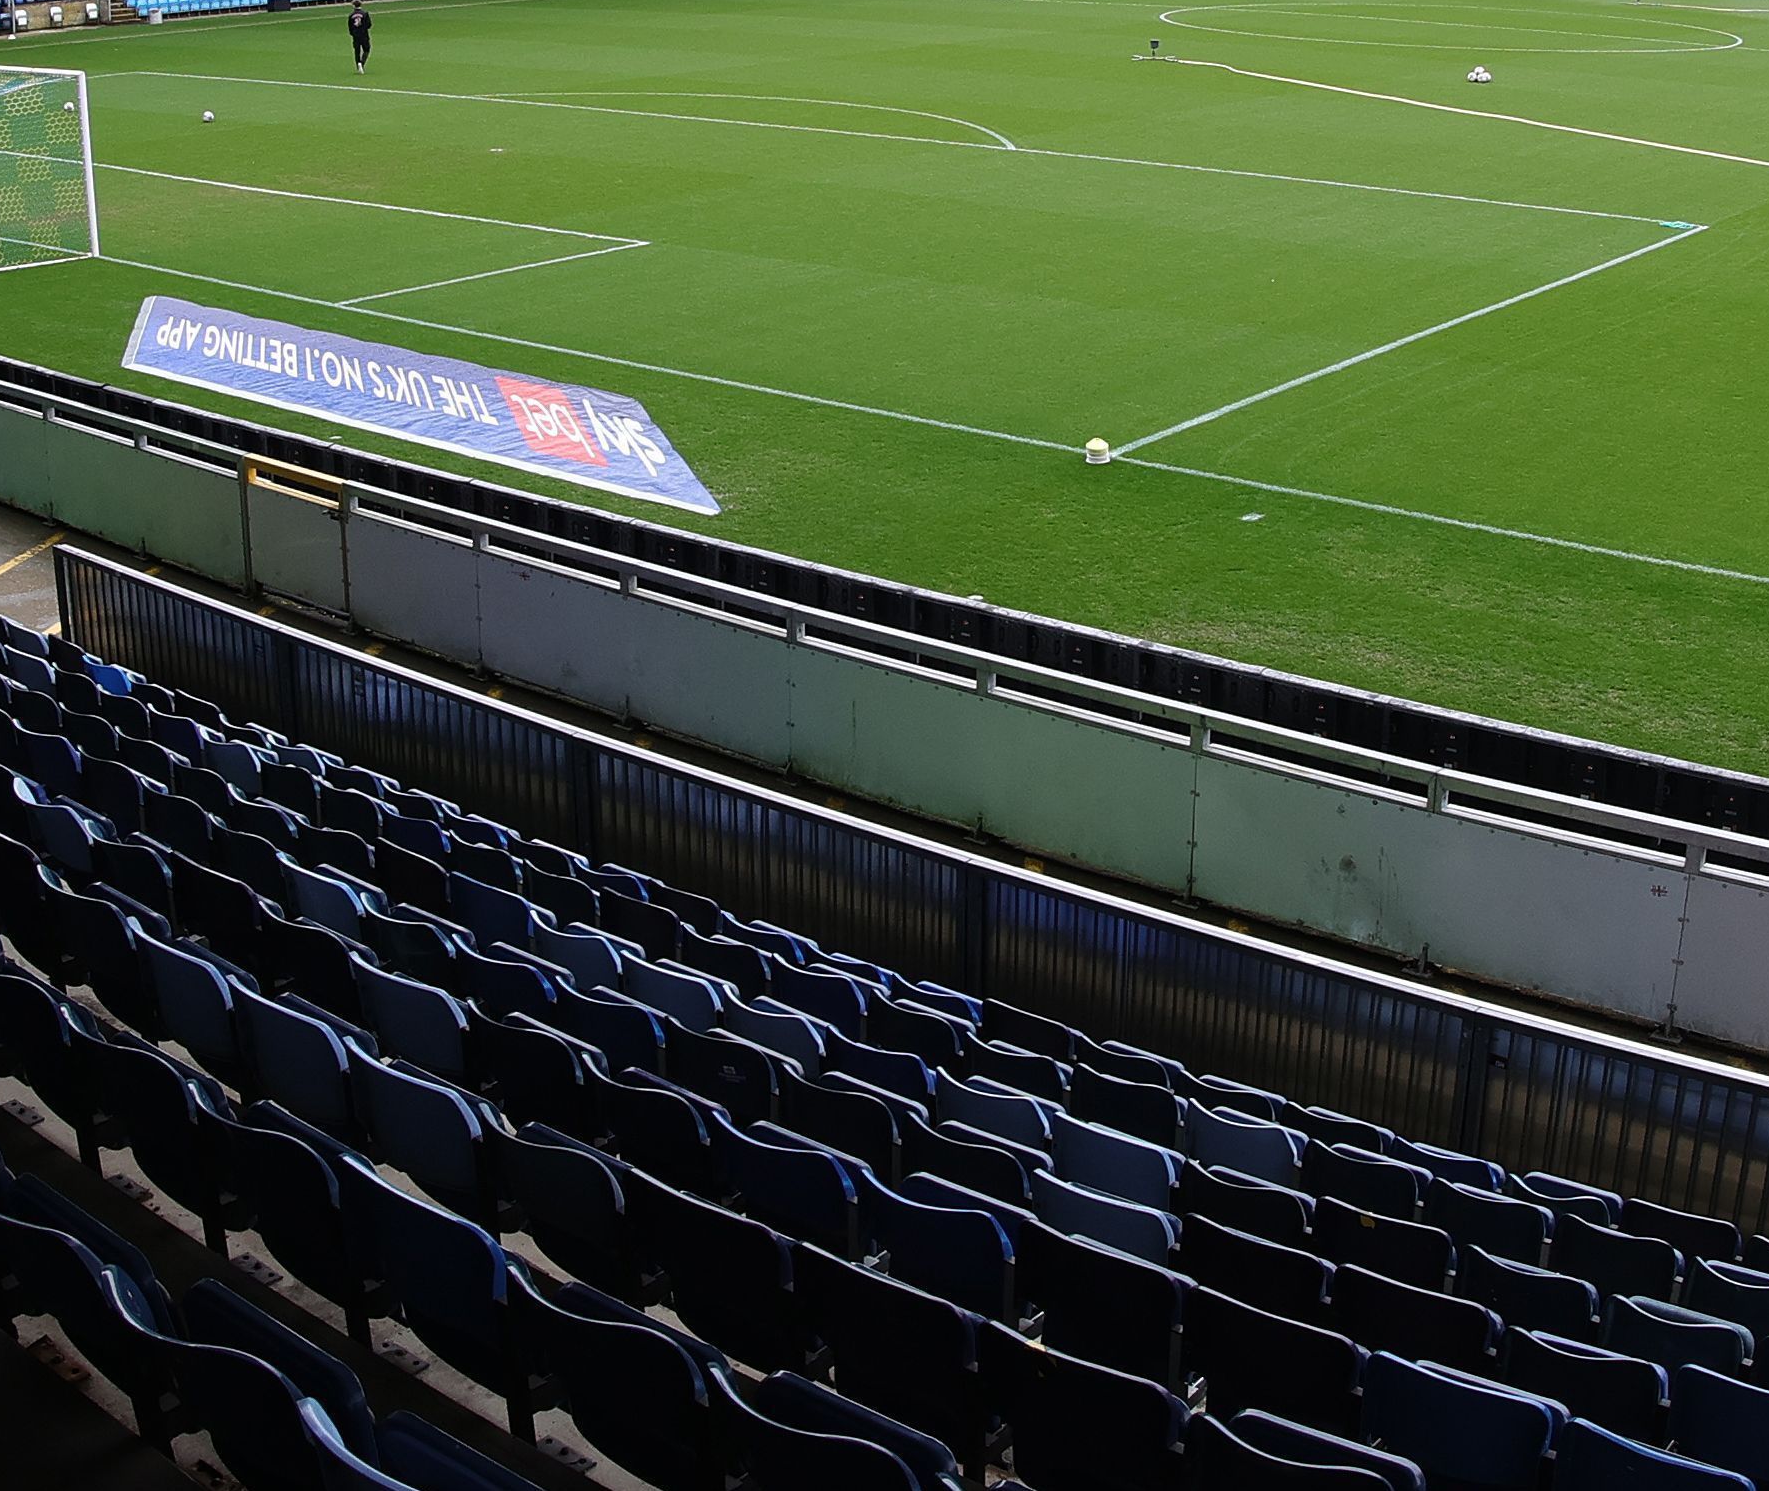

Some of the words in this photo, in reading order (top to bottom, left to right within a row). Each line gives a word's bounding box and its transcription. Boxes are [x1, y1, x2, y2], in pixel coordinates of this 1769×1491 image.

[156, 316, 202, 351] APP
[203, 325, 299, 378] BETTING
[305, 347, 365, 393] NO.1
[367, 361, 435, 410] UK'S
[431, 374, 499, 426] THE
[510, 394, 596, 458] bet
[582, 399, 665, 477] sky
